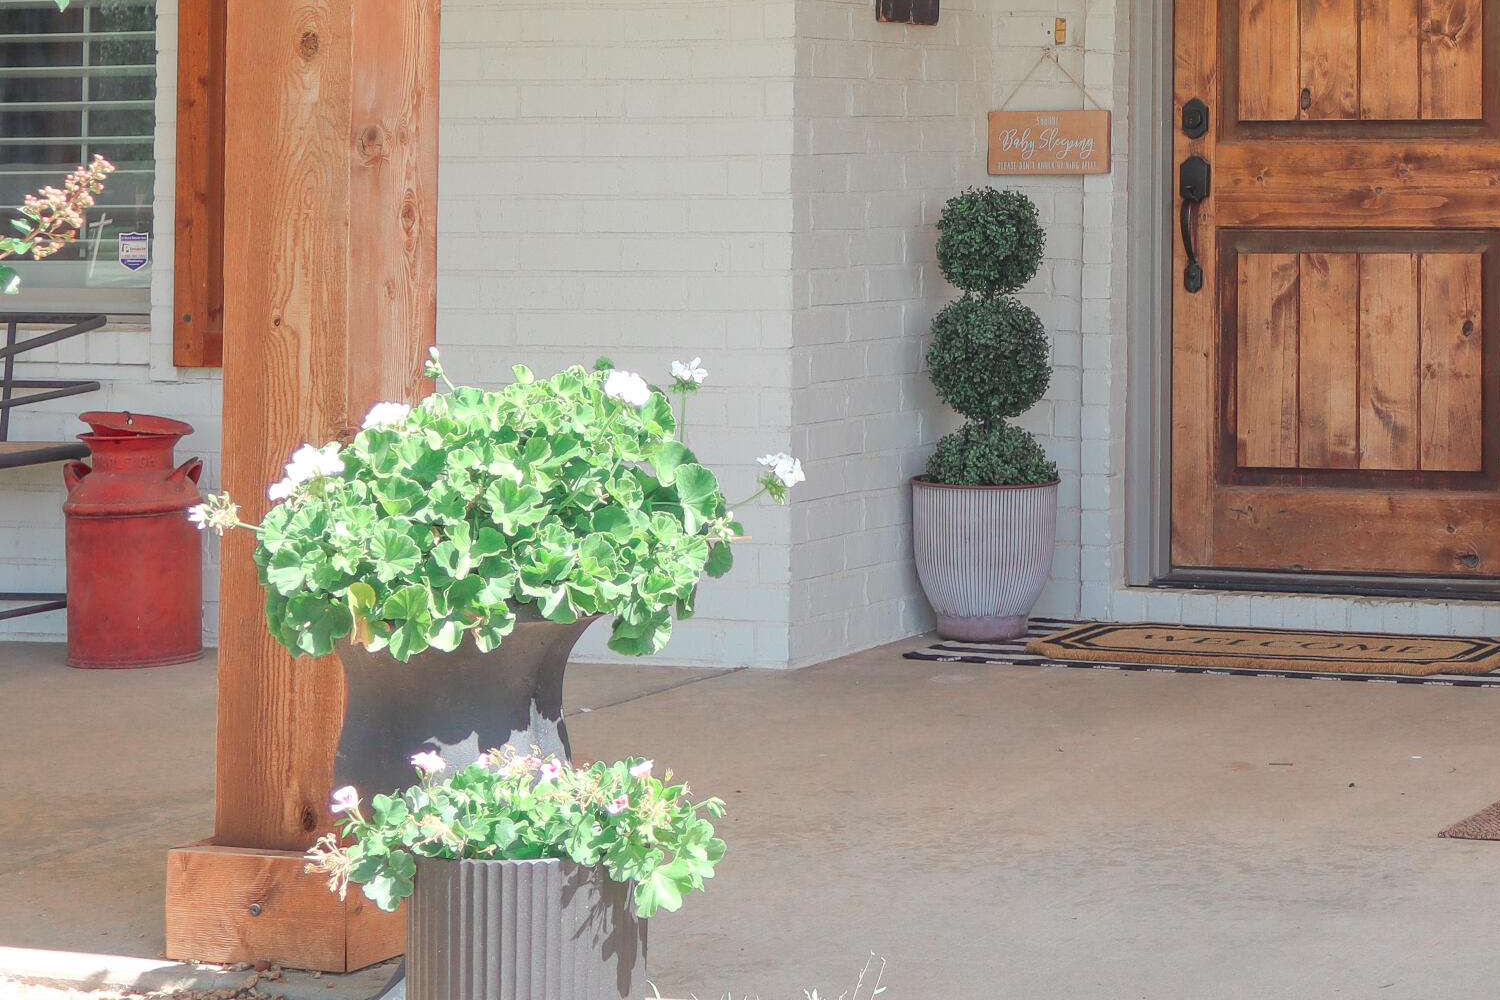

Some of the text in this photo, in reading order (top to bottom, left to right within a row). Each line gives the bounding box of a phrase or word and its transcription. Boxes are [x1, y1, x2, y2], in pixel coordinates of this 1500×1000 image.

[998, 127, 1095, 160] Baby Sleeping
[1144, 634, 1433, 653] WELCOME
